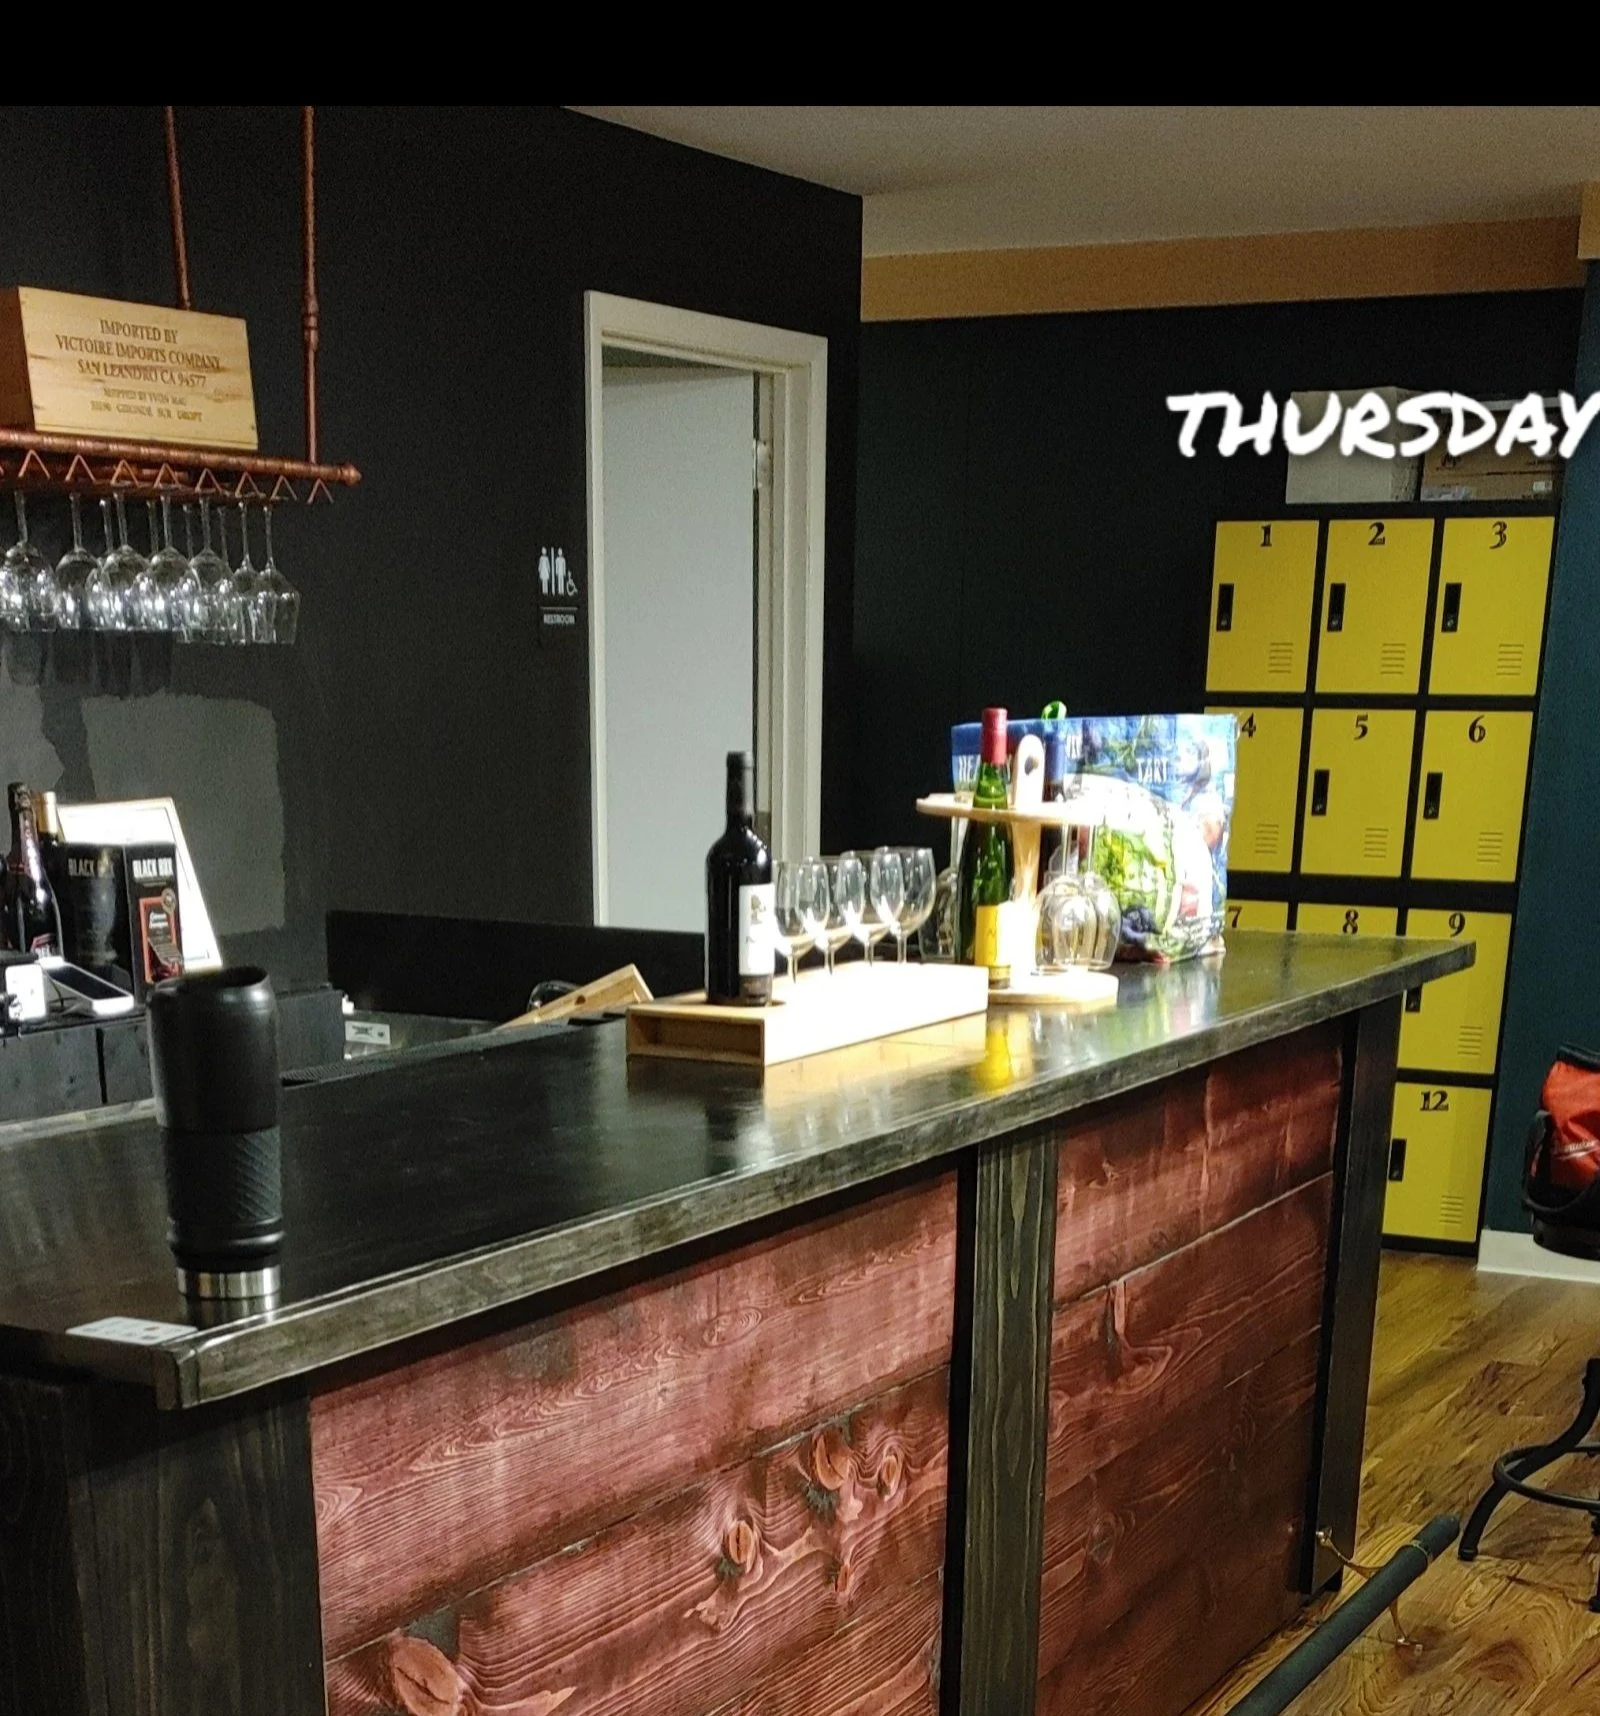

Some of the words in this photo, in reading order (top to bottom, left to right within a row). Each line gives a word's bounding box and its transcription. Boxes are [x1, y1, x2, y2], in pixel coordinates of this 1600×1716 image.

[100, 319, 161, 342] IMPORTED
[164, 328, 178, 344] BY
[55, 334, 115, 356] VICTOIRE
[115, 343, 167, 363] IMPORTS
[169, 350, 220, 369] COMPANY
[78, 359, 101, 376] SAN
[103, 362, 158, 381] LEANDRO
[160, 371, 176, 385] CA
[178, 373, 207, 388] 94577
[1260, 524, 1273, 548] 1
[1368, 523, 1386, 546] 2
[1489, 521, 1507, 549] 3
[1241, 712, 1257, 739] 4
[1354, 714, 1369, 740] 5
[1468, 715, 1487, 743] 6
[68, 858, 96, 877] BLACK
[132, 858, 158, 880] BLACK
[158, 857, 174, 877] BOX
[1228, 906, 1242, 928] 7
[1342, 909, 1359, 934] 8
[1448, 912, 1466, 937] 9
[1420, 1090, 1449, 1112] 12
